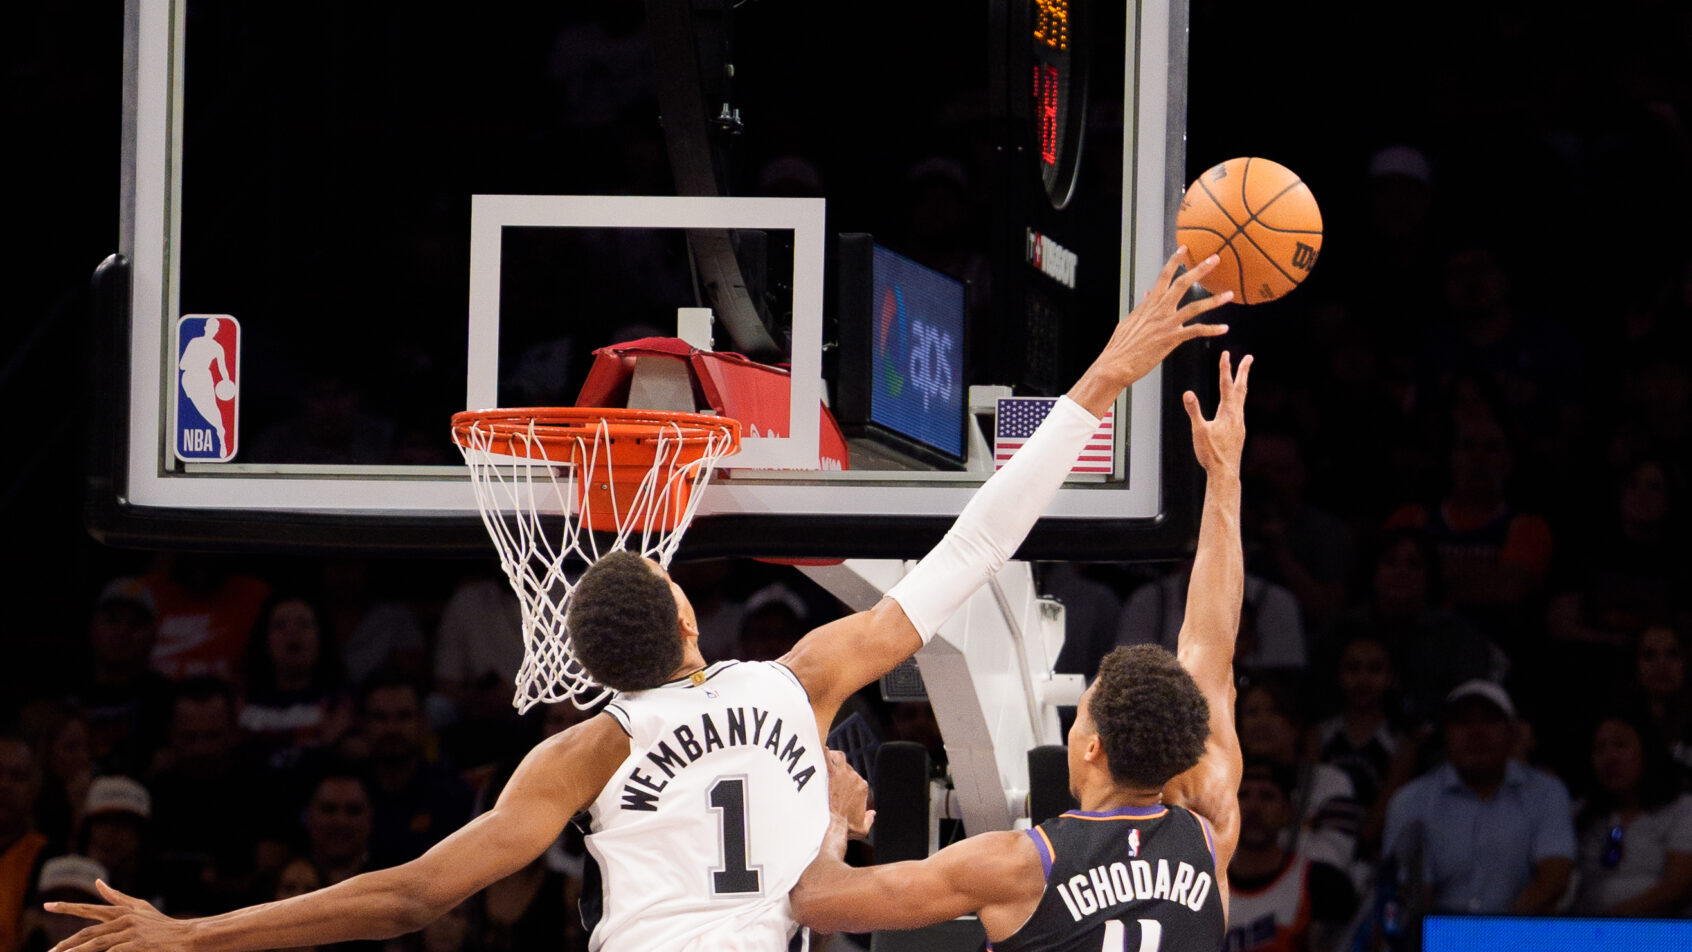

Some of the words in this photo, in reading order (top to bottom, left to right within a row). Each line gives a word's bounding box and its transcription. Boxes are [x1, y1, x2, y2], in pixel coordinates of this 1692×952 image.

[910, 319, 953, 412] aps
[183, 428, 214, 452] NBA
[620, 706, 816, 812] WEMBANYAMA
[706, 774, 764, 899] 1
[1056, 858, 1212, 922] IGHODARO
